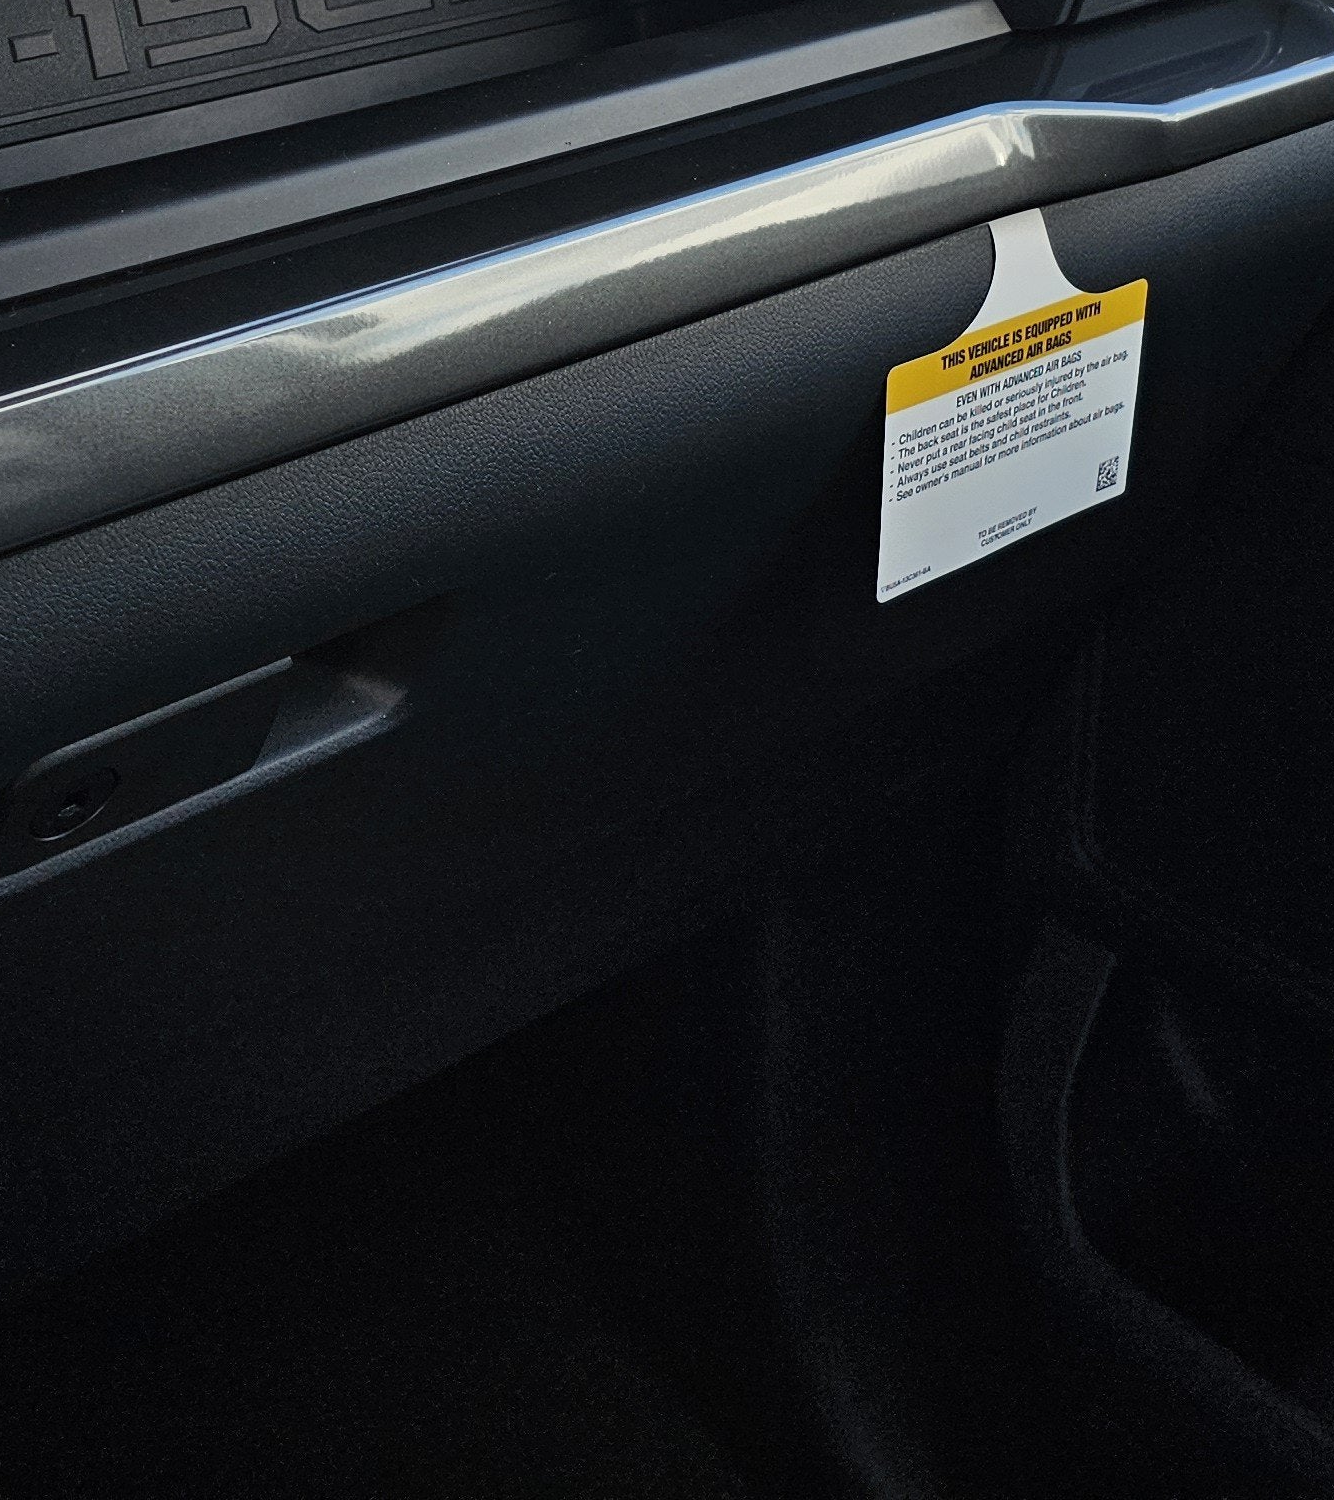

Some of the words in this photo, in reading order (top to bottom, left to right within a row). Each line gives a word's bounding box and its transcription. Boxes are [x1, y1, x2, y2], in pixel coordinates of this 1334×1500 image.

[941, 350, 965, 370] THIS
[968, 332, 1010, 360] VEHICLE
[1012, 328, 1022, 345] IS
[1025, 311, 1072, 340] EQUIPPED
[1076, 301, 1101, 322] WITH
[969, 348, 1024, 381] ADVANCED
[1026, 342, 1043, 359] AIR
[1046, 330, 1072, 352] BAGS
[899, 423, 937, 445] Children
[939, 417, 955, 430] can
[956, 412, 968, 423] be
[970, 400, 993, 418] killed
[994, 399, 1004, 409] or
[1005, 381, 1043, 404] seriously
[1045, 368, 1073, 388] injured
[1074, 366, 1085, 378] by
[1087, 360, 1100, 373] the
[1100, 355, 1112, 368] air
[956, 388, 978, 408] EVEN
[979, 381, 1001, 399] WITH
[1002, 364, 1044, 391] ADVANCED
[1045, 356, 1059, 374] AIR
[1061, 350, 1082, 368] BAGS
[896, 487, 914, 502] See
[915, 472, 950, 495] owner's
[950, 457, 983, 480] manual
[984, 452, 997, 465] for
[997, 446, 1020, 460] more
[1020, 423, 1068, 451] information
[1068, 413, 1091, 431] about
[1092, 408, 1104, 421] air
[896, 467, 929, 488] Always
[930, 460, 948, 474] use
[949, 450, 967, 467] seat
[969, 443, 990, 459] belts
[991, 433, 1008, 449] and
[1009, 425, 1030, 442] child
[898, 455, 925, 474] Never
[925, 450, 940, 465] put
[942, 446, 948, 456] a
[949, 438, 968, 454] rear
[969, 427, 995, 445] facing
[996, 418, 1018, 434] child
[1019, 409, 1037, 424] seat
[1038, 406, 1046, 417] in
[1047, 401, 1061, 414] the
[899, 445, 916, 459] The
[917, 435, 939, 453] back
[940, 427, 960, 443] seat
[961, 424, 969, 435] is
[970, 418, 985, 431] the
[986, 406, 1012, 425] safest
[1013, 398, 1036, 417] place
[1037, 392, 1050, 405] for
[978, 529, 987, 539] TO
[988, 524, 997, 535] BE
[997, 511, 1028, 530] REMOVED
[1028, 506, 1038, 516] BY
[981, 525, 1015, 547] CUSTOMER
[1016, 517, 1033, 531] ONLY
